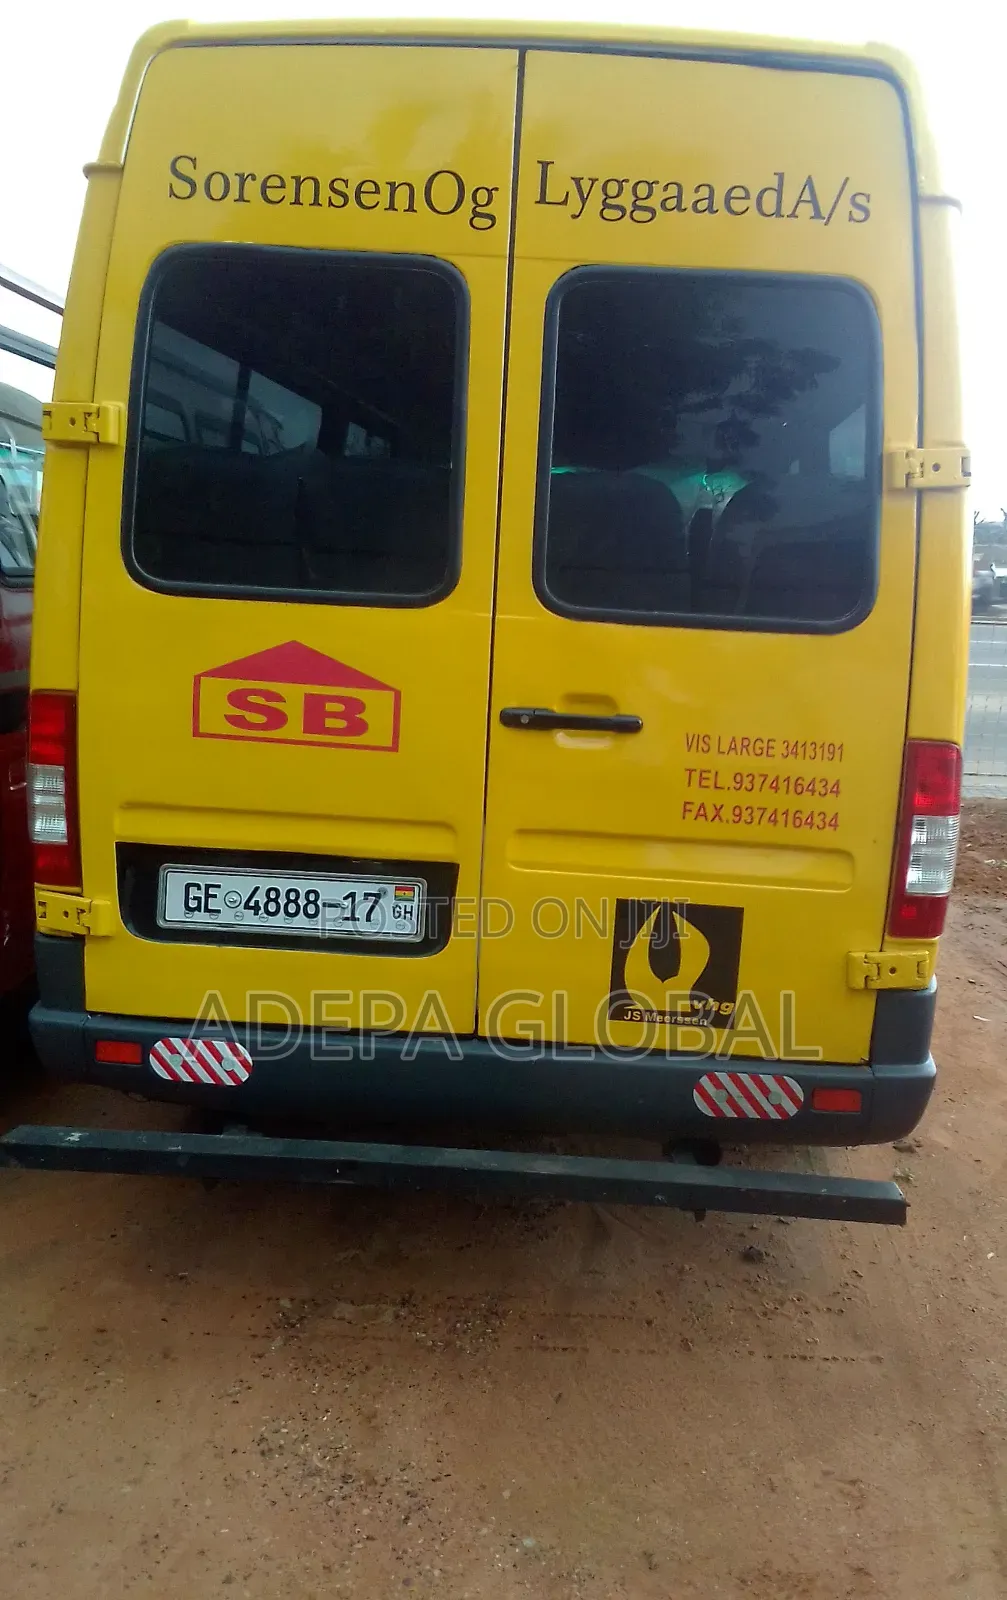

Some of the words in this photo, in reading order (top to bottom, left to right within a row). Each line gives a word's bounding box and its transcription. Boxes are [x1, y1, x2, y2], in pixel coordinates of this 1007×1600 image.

[169, 155, 499, 231] SorensenOg
[534, 159, 872, 226] LyggaaedA/s
[224, 688, 369, 737] SB
[686, 733, 711, 754] VIS
[717, 736, 776, 758] LARGE
[781, 740, 844, 762] 3413191
[685, 768, 841, 798] TEL.937416434
[682, 801, 839, 831] FAX.937416434
[184, 882, 221, 914] GE
[392, 904, 413, 920] GH
[623, 1010, 641, 1021] JS
